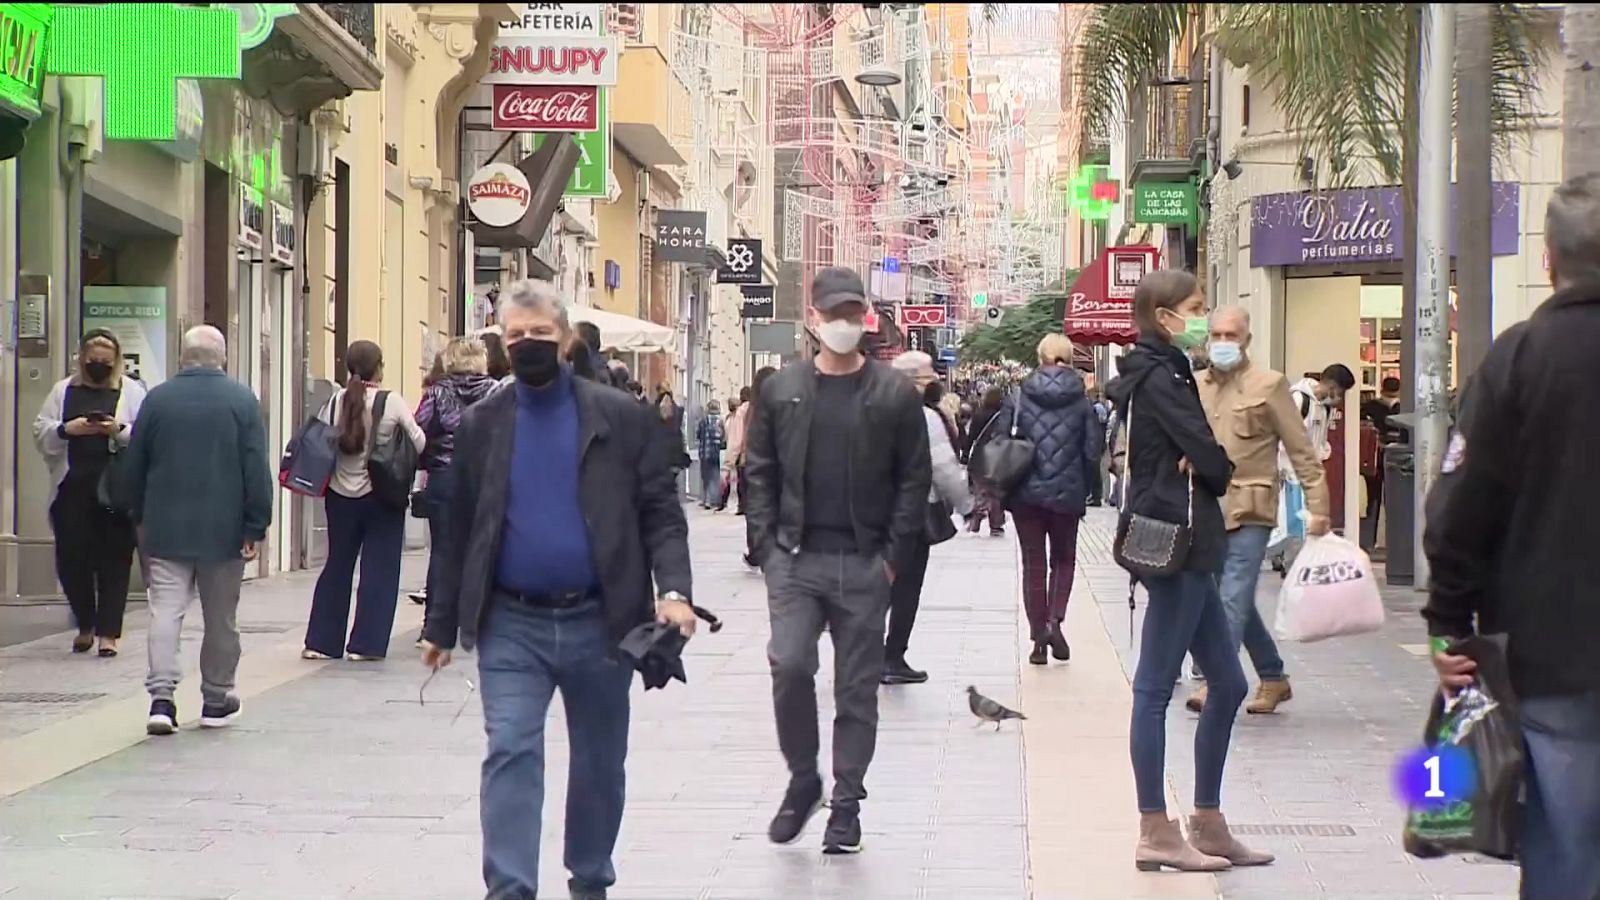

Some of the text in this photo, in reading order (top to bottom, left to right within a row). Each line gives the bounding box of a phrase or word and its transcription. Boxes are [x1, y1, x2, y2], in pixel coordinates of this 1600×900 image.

[499, 90, 594, 123] Coca-Cola
[471, 183, 526, 199] SAIMAZA
[1144, 190, 1185, 198] LA CASA
[1164, 199, 1182, 207] LAS
[1302, 196, 1392, 242] Dalia
[660, 226, 703, 235] ZARA
[659, 238, 703, 247] HOME
